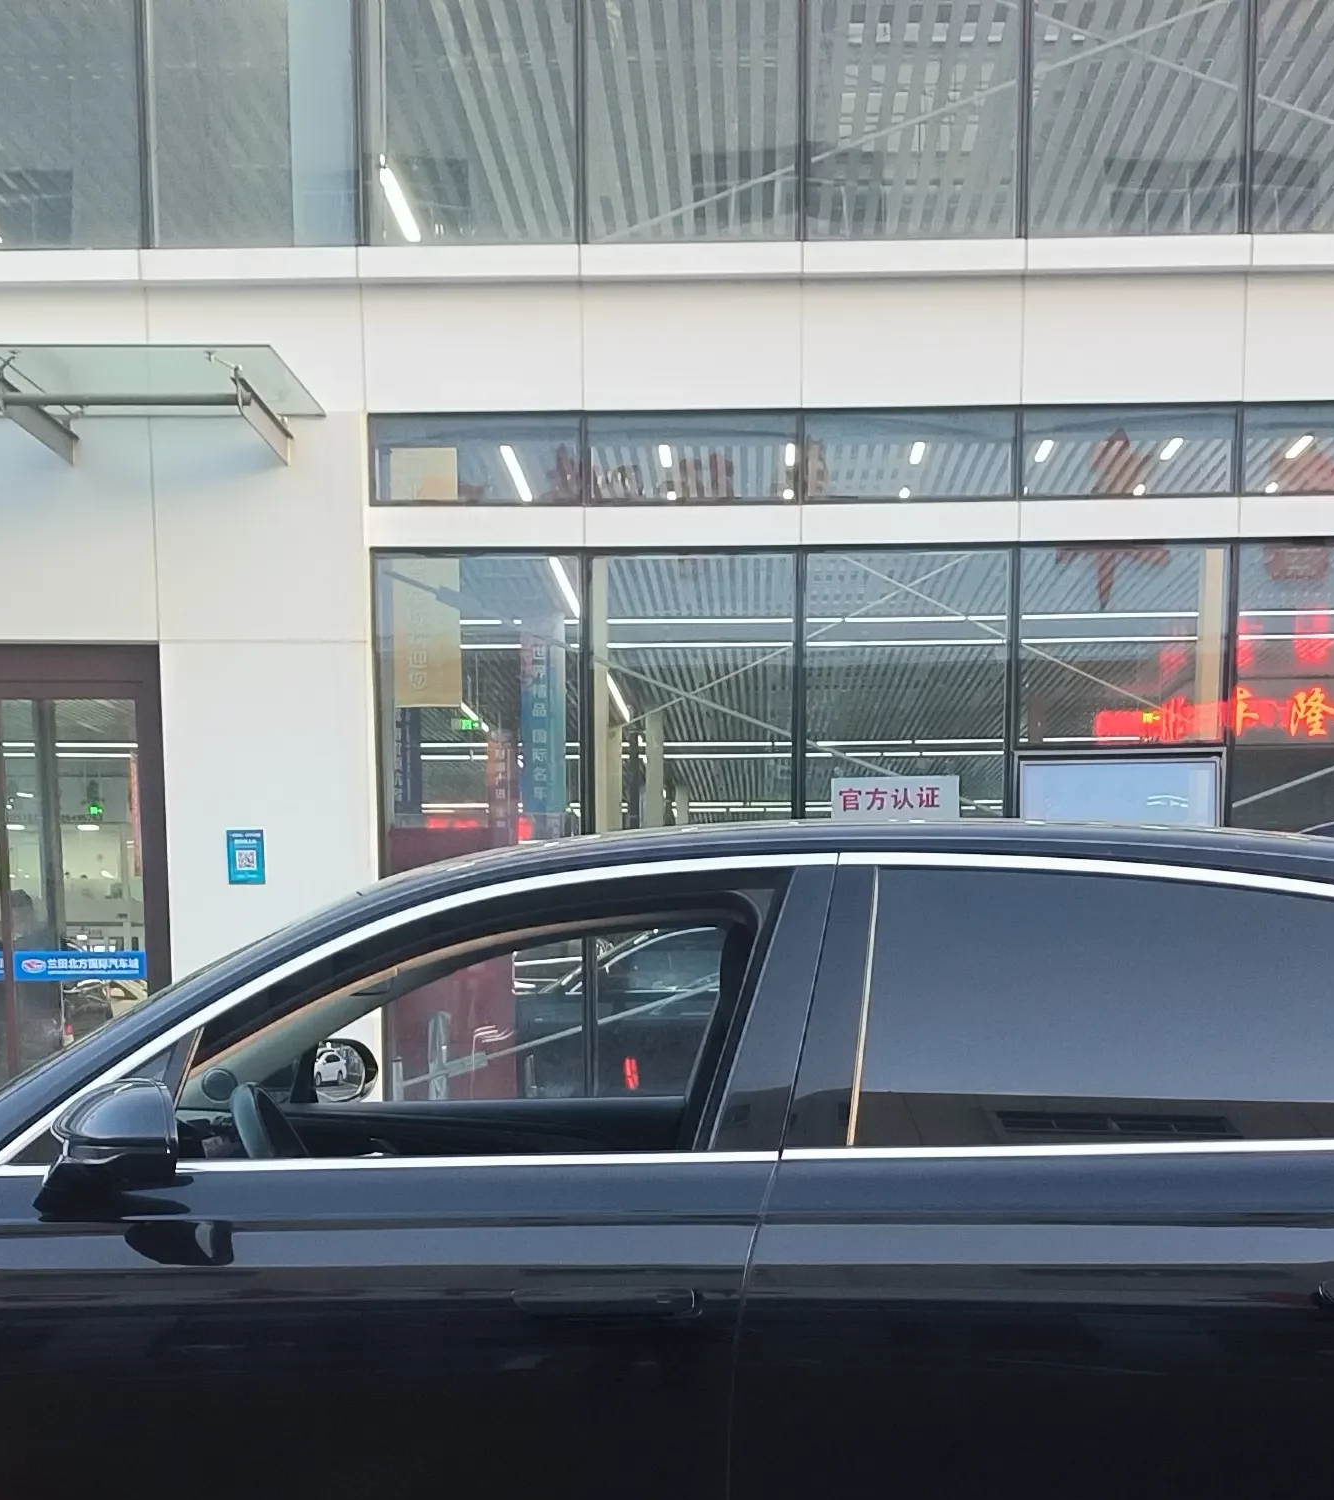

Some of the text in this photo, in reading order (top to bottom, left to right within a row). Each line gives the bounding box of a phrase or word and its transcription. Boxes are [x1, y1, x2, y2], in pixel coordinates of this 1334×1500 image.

[838, 786, 940, 811] 官方认证
[47, 958, 140, 970] 兰田北方国际汽车城
